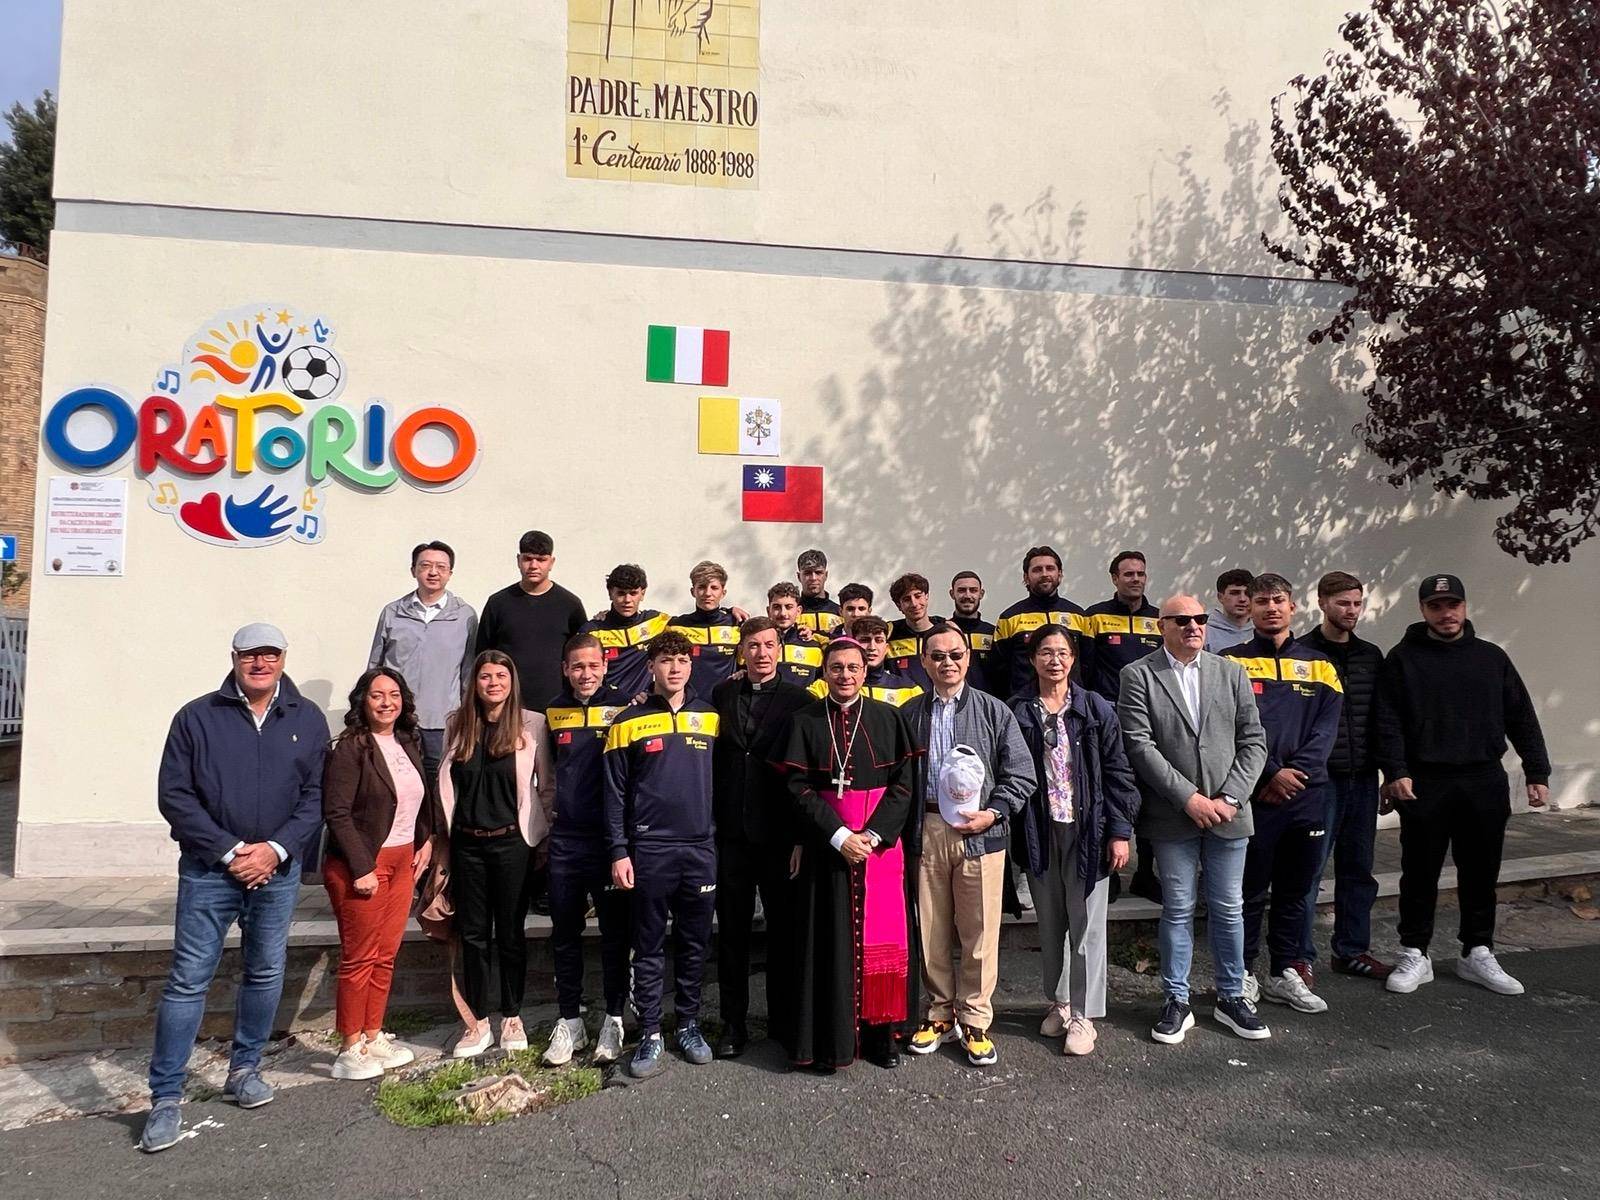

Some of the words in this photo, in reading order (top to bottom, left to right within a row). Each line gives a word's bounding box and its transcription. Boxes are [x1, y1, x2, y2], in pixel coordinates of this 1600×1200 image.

[570, 76, 642, 118] PADRE
[653, 83, 758, 127] MAESTRO
[592, 130, 682, 172] Centenario
[45, 387, 477, 489] ORATORIO
